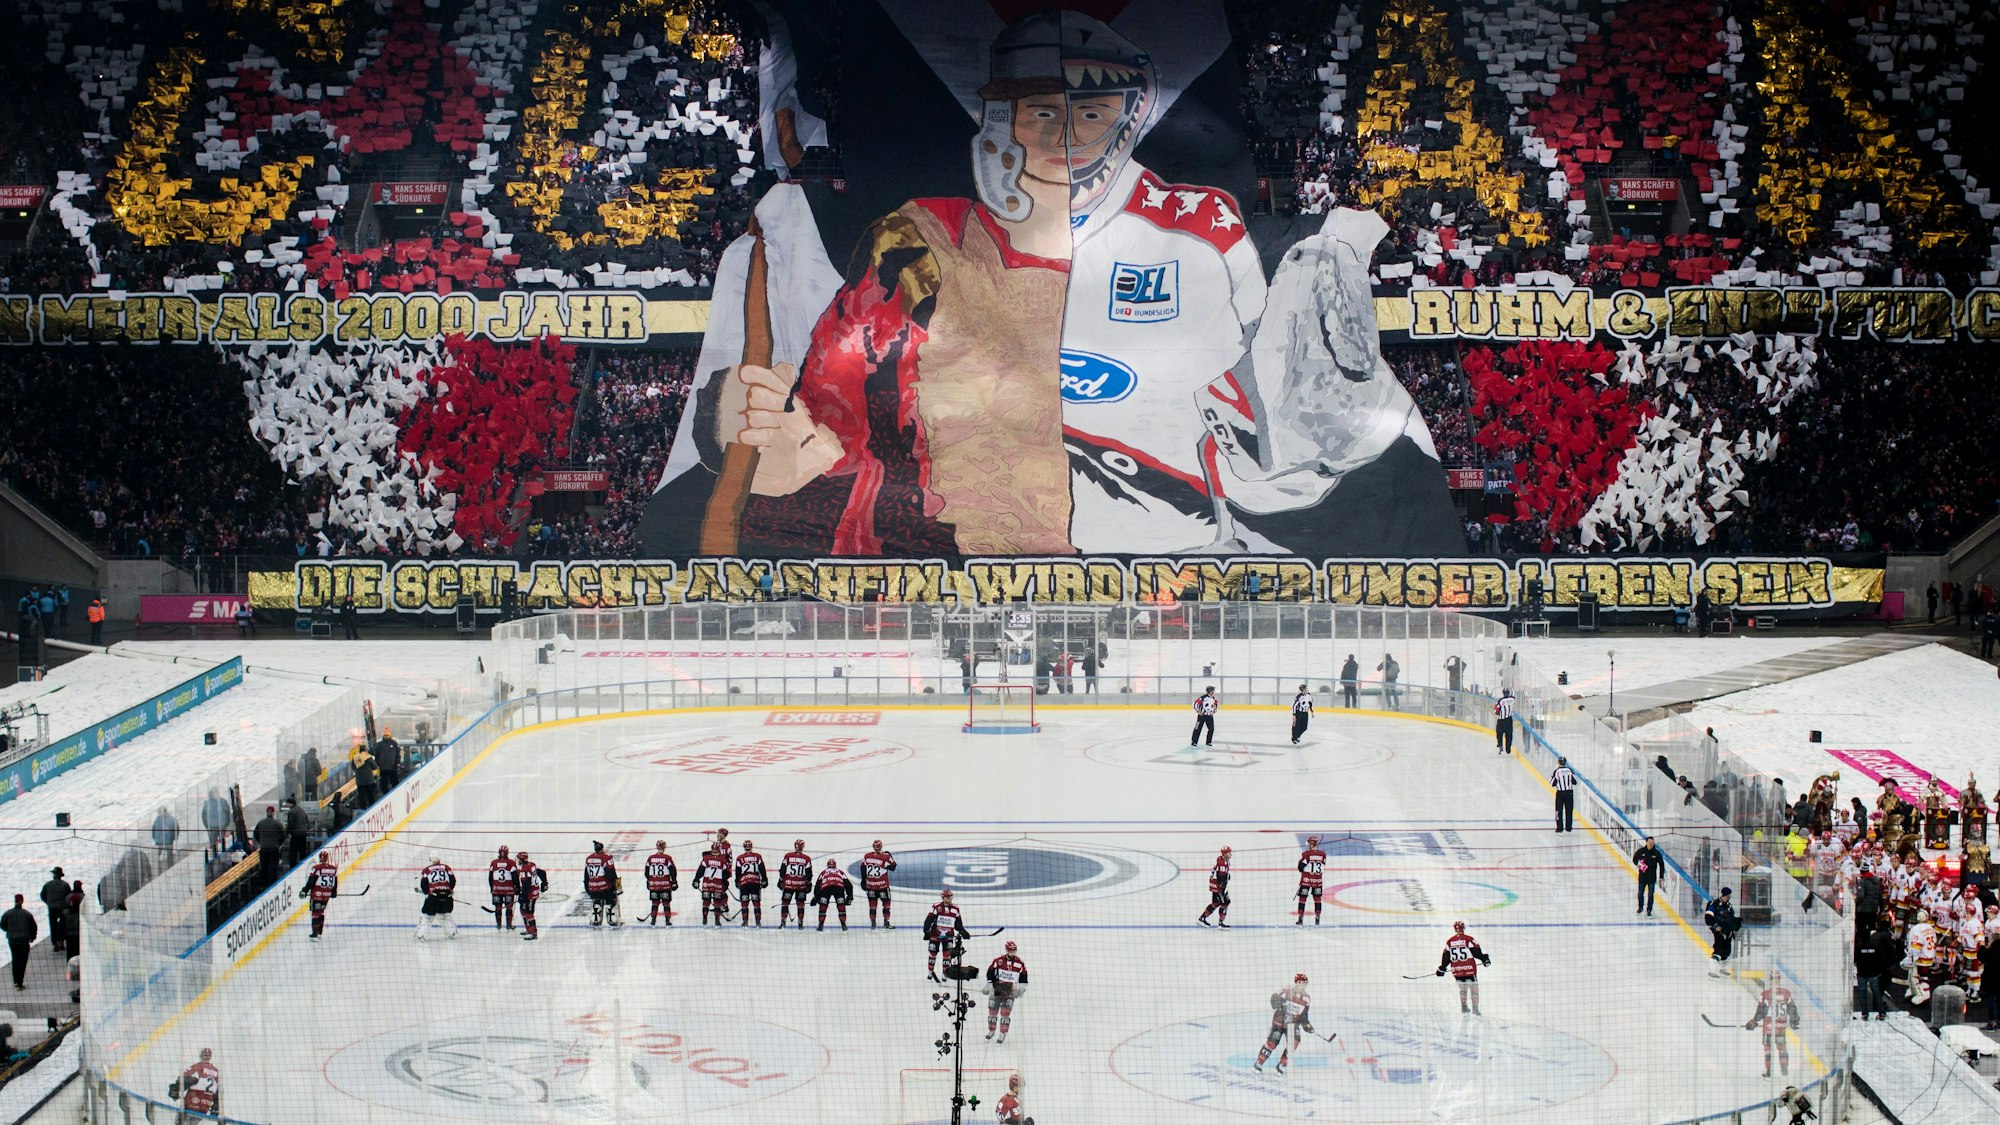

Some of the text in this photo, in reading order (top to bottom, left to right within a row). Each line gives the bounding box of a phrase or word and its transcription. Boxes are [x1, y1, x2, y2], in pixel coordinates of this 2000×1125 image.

[394, 184, 448, 192] HANS SCHÄFER
[1622, 181, 1641, 189] HANS
[394, 194, 432, 202] SÜDKURVE
[1622, 190, 1659, 198] SÜDKURVE
[1116, 267, 1171, 303] DEL
[41, 296, 199, 342] MEHR
[212, 296, 326, 342] ALS
[336, 294, 477, 340] 2000
[487, 293, 646, 338] JAHR
[1411, 289, 1592, 338] RUHM
[1608, 290, 1653, 337] &
[574, 472, 604, 481] SCHÄFER
[554, 482, 590, 490] SÜDKURVE
[300, 563, 383, 608] DIE
[967, 562, 1123, 604] WIRD
[1132, 561, 1314, 604] IMMER
[1326, 561, 1507, 608] UNSER
[1703, 560, 1830, 606] SEIN
[772, 712, 877, 724] EXPRESS
[104, 710, 147, 745] sportwetten.de
[40, 738, 87, 775] sportwetten.de
[650, 738, 804, 766] Rhein
[681, 736, 872, 775] Energie
[366, 801, 394, 839] TOYOTA
[498, 868, 506, 882] 3
[587, 864, 602, 878] 67
[652, 864, 666, 878] 18
[710, 866, 718, 880] 7
[743, 862, 758, 874] 21
[789, 864, 804, 878] 50
[866, 864, 882, 878] 23
[1310, 861, 1322, 875] 13
[320, 874, 335, 888] 59
[430, 869, 446, 884] 29
[226, 880, 292, 962] sportwetten.de
[1450, 946, 1468, 962] 55
